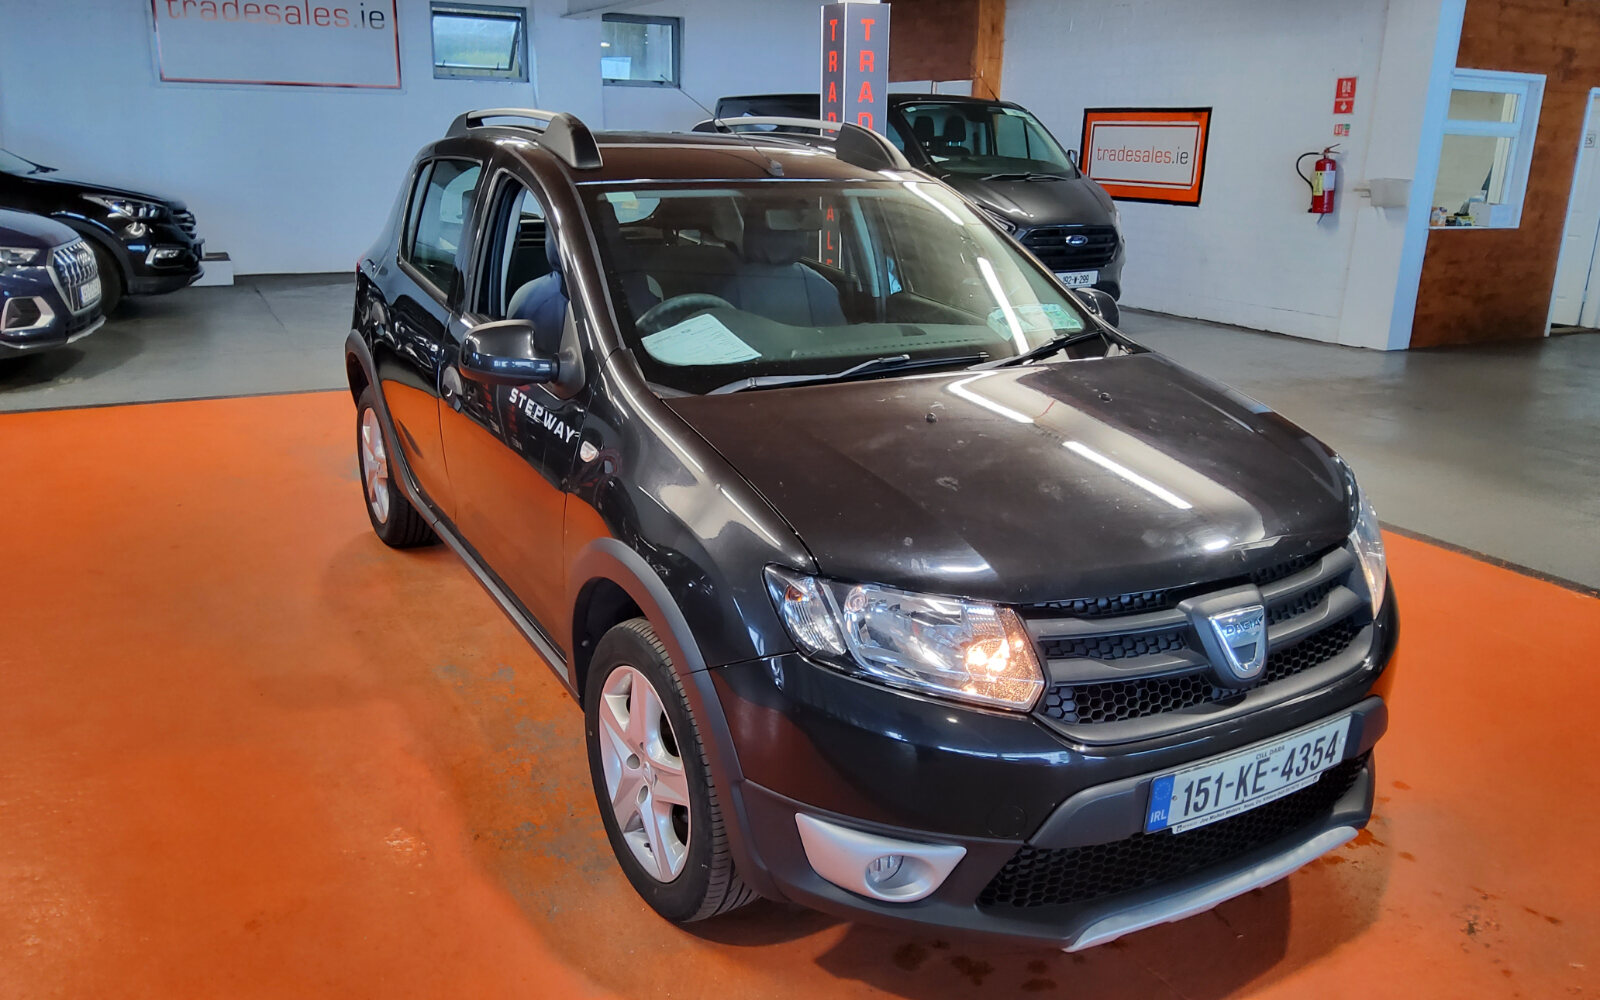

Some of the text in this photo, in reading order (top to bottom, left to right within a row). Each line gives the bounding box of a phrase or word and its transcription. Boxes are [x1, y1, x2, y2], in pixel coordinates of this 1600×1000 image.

[167, 0, 386, 30] tradesales.ie
[1096, 144, 1189, 165] tradesales.ie
[508, 387, 577, 443] STEPWAY
[1225, 618, 1262, 635] DACIA
[1183, 729, 1340, 817] 151-KE-4354
[1150, 808, 1167, 823] IRL
